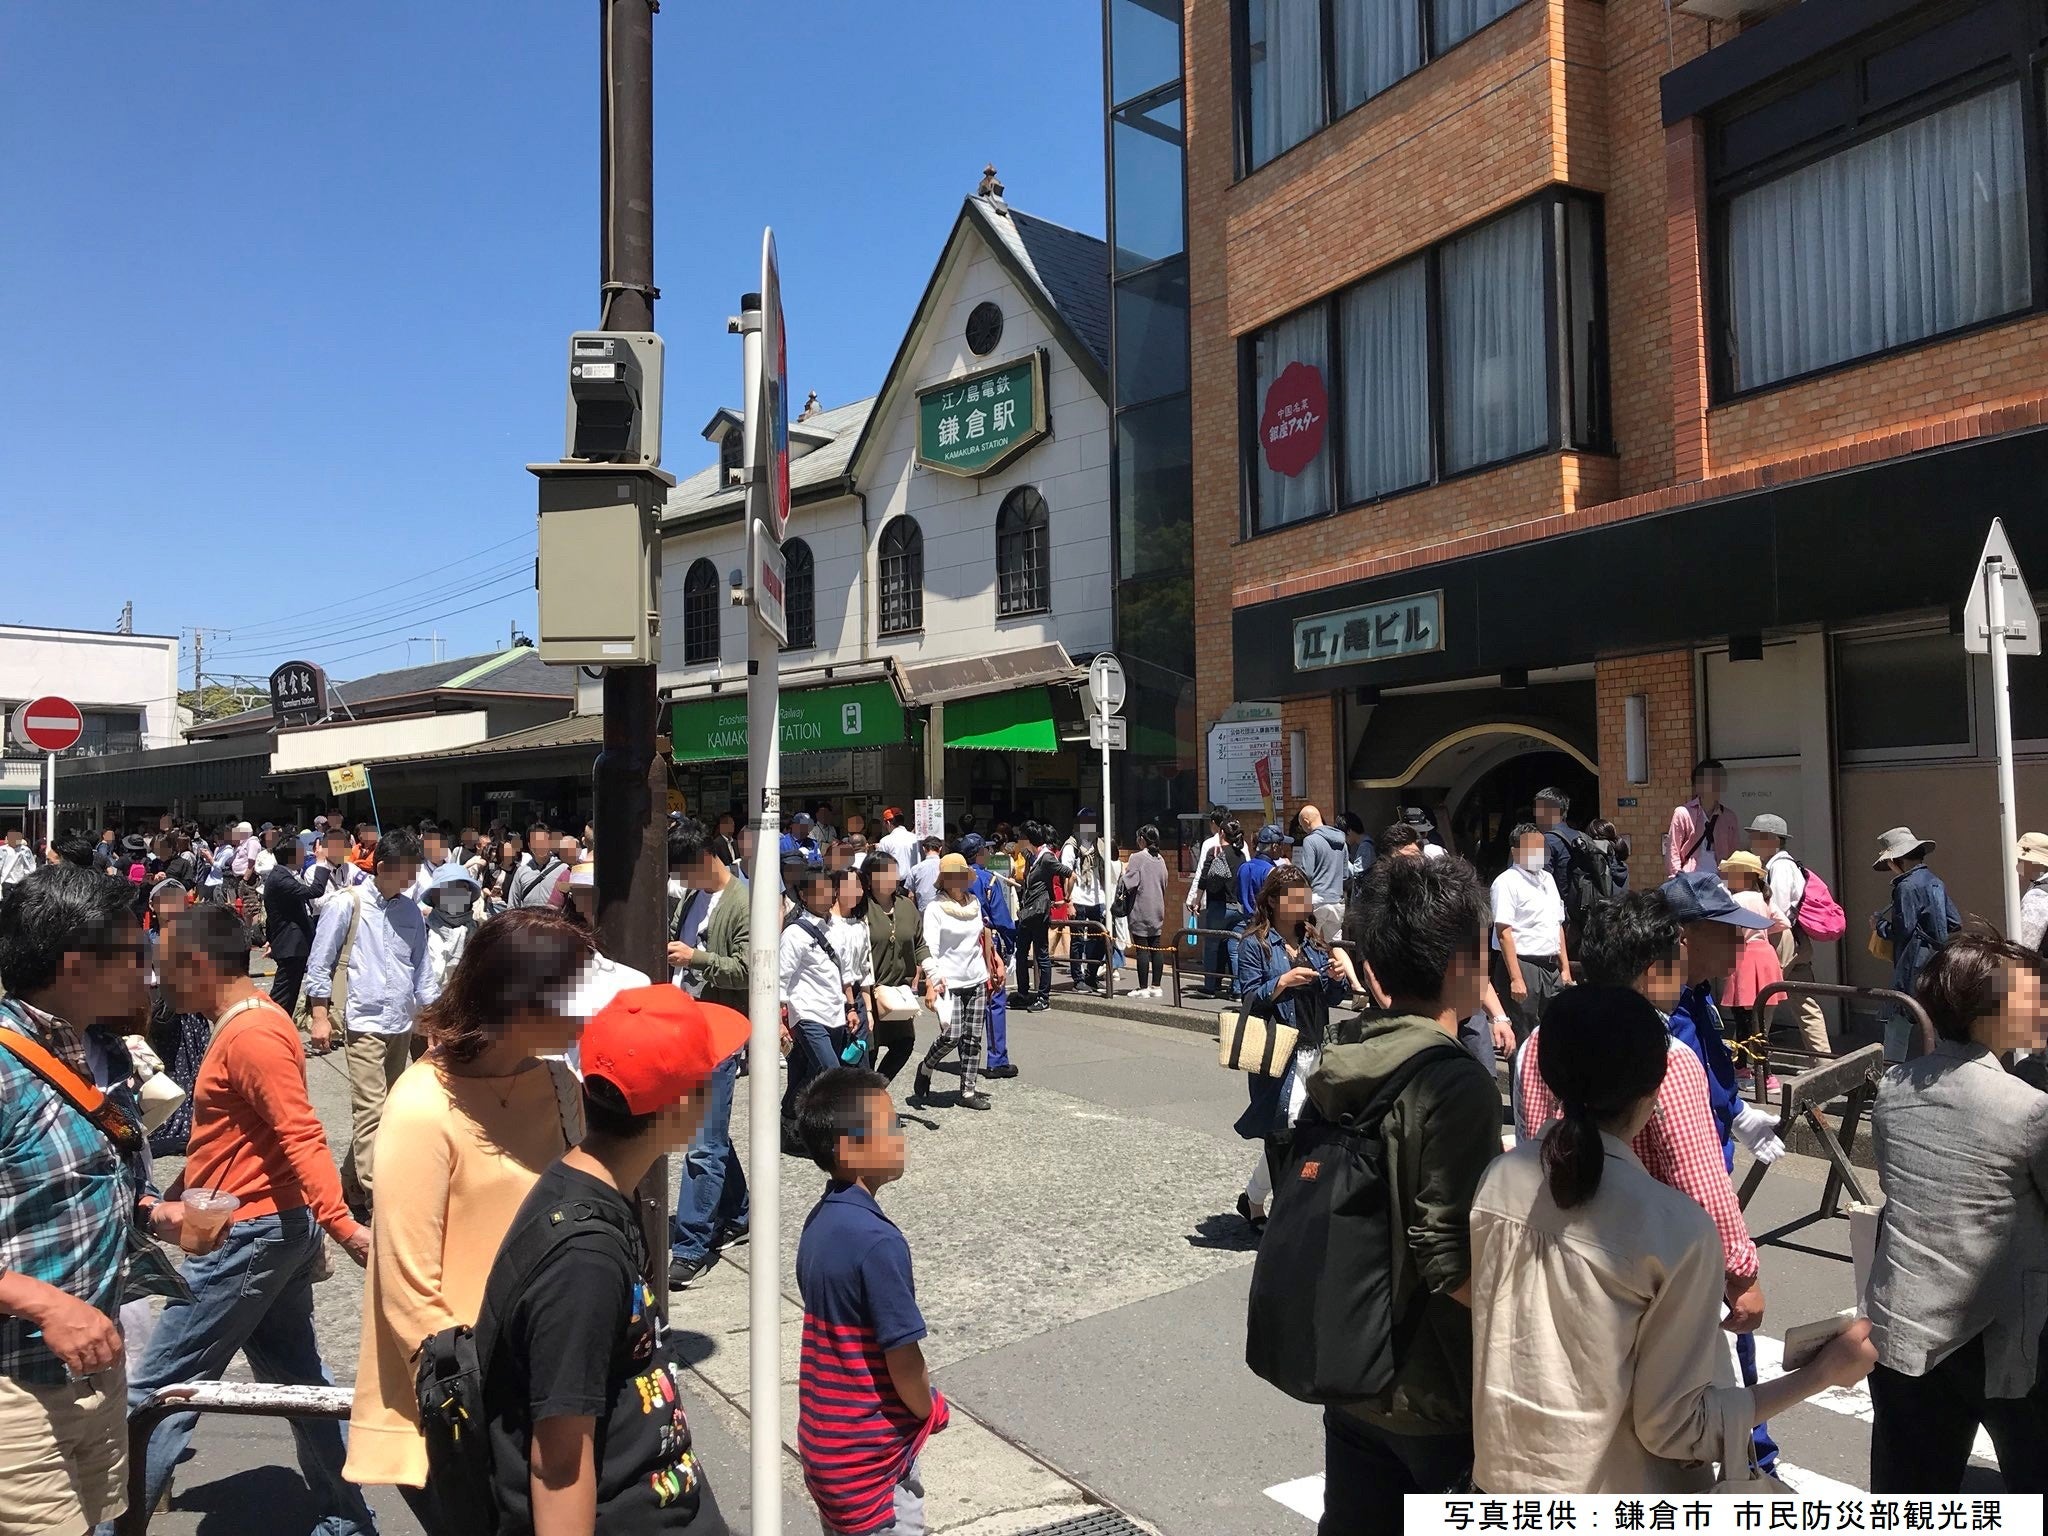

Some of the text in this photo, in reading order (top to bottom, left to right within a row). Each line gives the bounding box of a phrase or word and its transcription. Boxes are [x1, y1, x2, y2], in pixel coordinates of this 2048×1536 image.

[942, 375, 1011, 411] 江ノ島電鉄
[1277, 398, 1309, 419] 中国名菜
[938, 399, 1015, 447] 鎌倉駅
[1269, 411, 1320, 443] 銀座アスター
[944, 437, 1009, 460] KAMAKURA STATION
[1302, 606, 1430, 660] 江ノ電ビル
[277, 670, 312, 697] 鎌倉駅
[780, 708, 805, 719] Railway
[779, 722, 821, 741] TATION
[667, 802, 684, 810] AXI
